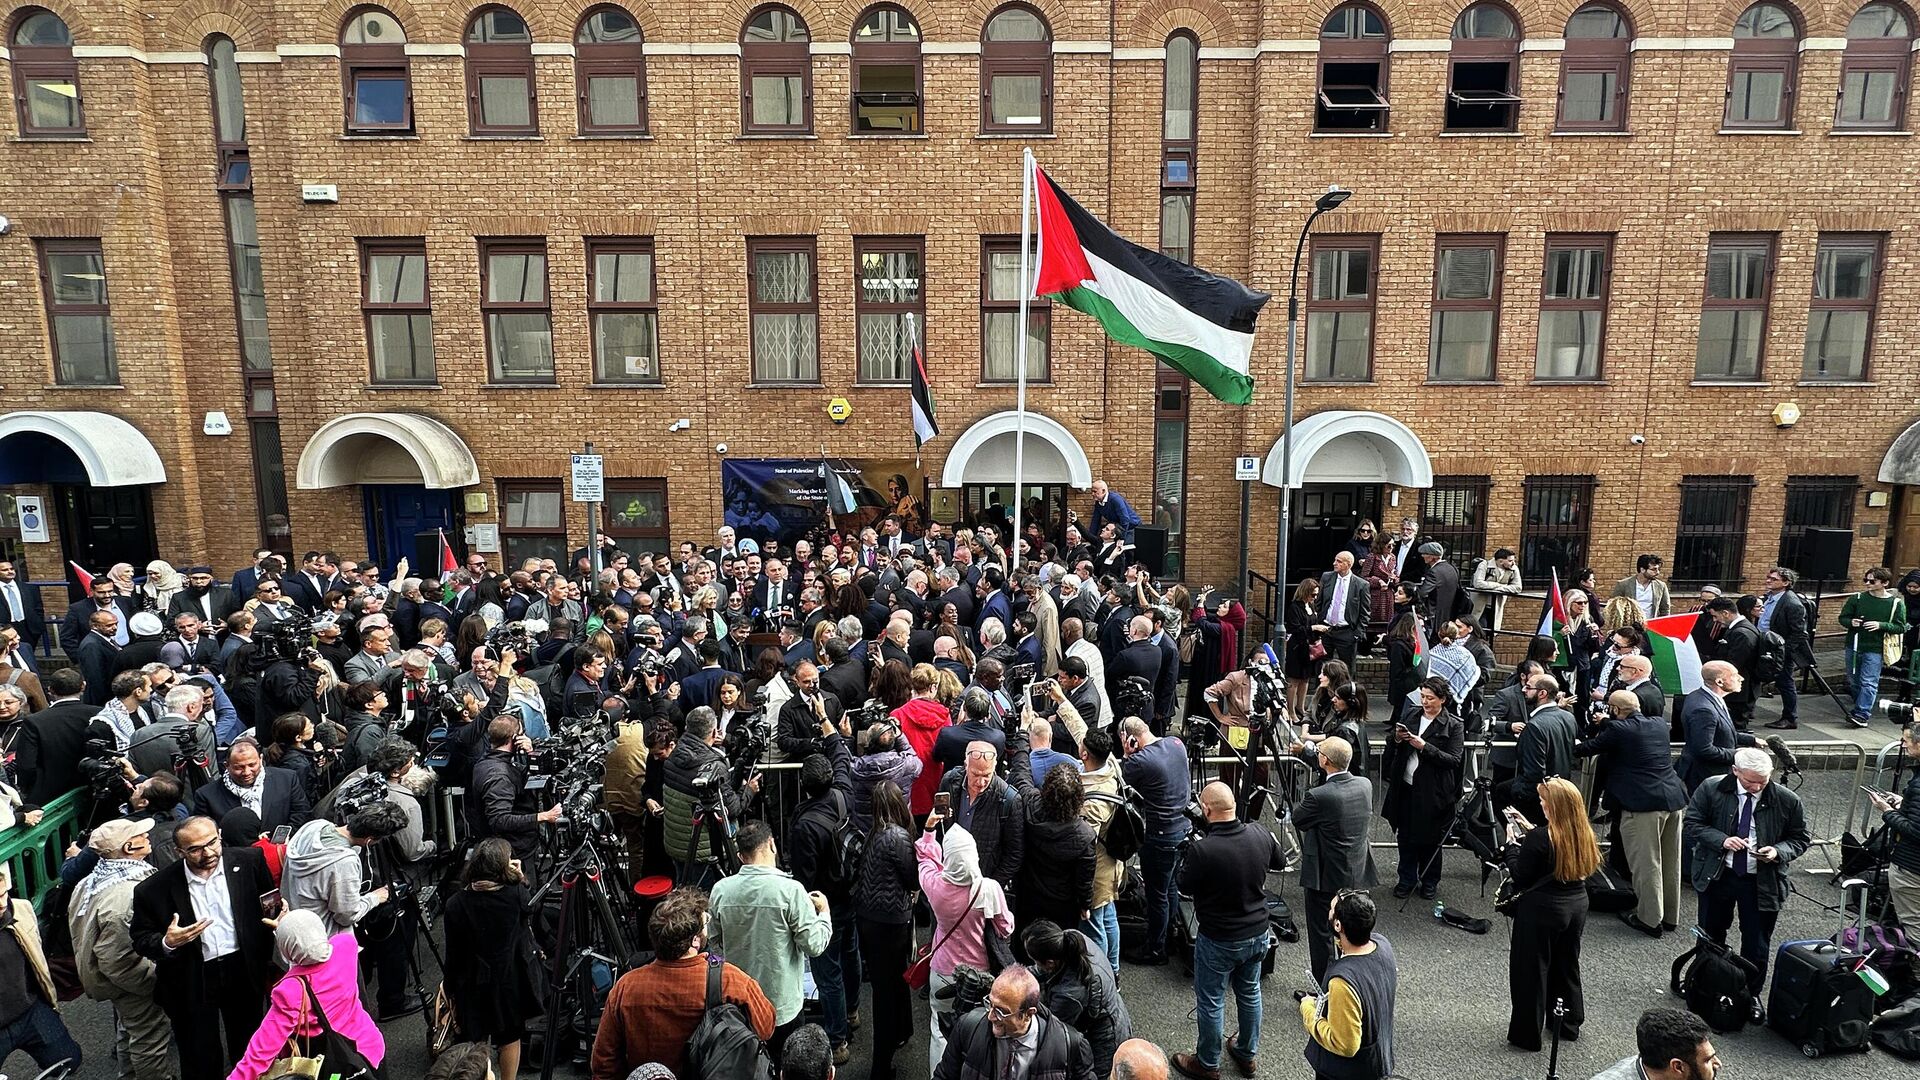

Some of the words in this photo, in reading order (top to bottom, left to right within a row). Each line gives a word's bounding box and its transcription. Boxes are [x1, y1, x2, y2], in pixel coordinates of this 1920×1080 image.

[832, 405, 843, 414] ADT
[22, 505, 38, 513] KP
[1323, 518, 1330, 526] 7
